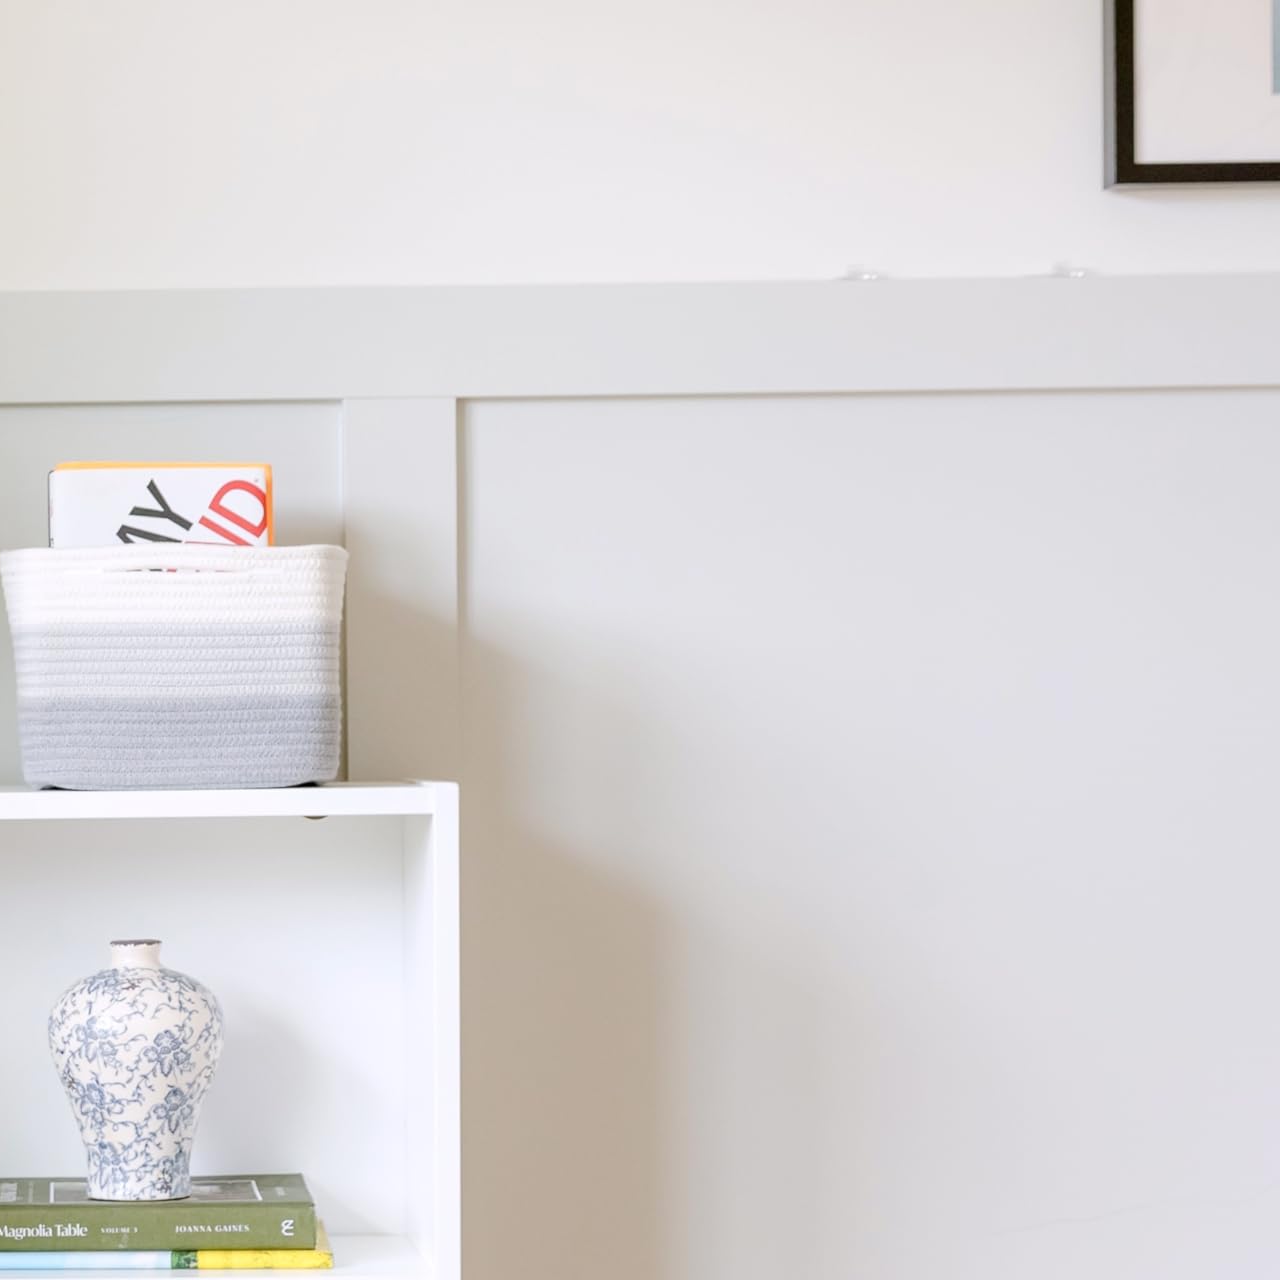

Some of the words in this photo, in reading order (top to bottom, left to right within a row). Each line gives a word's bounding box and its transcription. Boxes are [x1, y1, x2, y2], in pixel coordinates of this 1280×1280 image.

[54, 1223, 88, 1237] Table
[175, 1225, 212, 1233] JOANNA
[215, 1224, 250, 1232] GAINES
